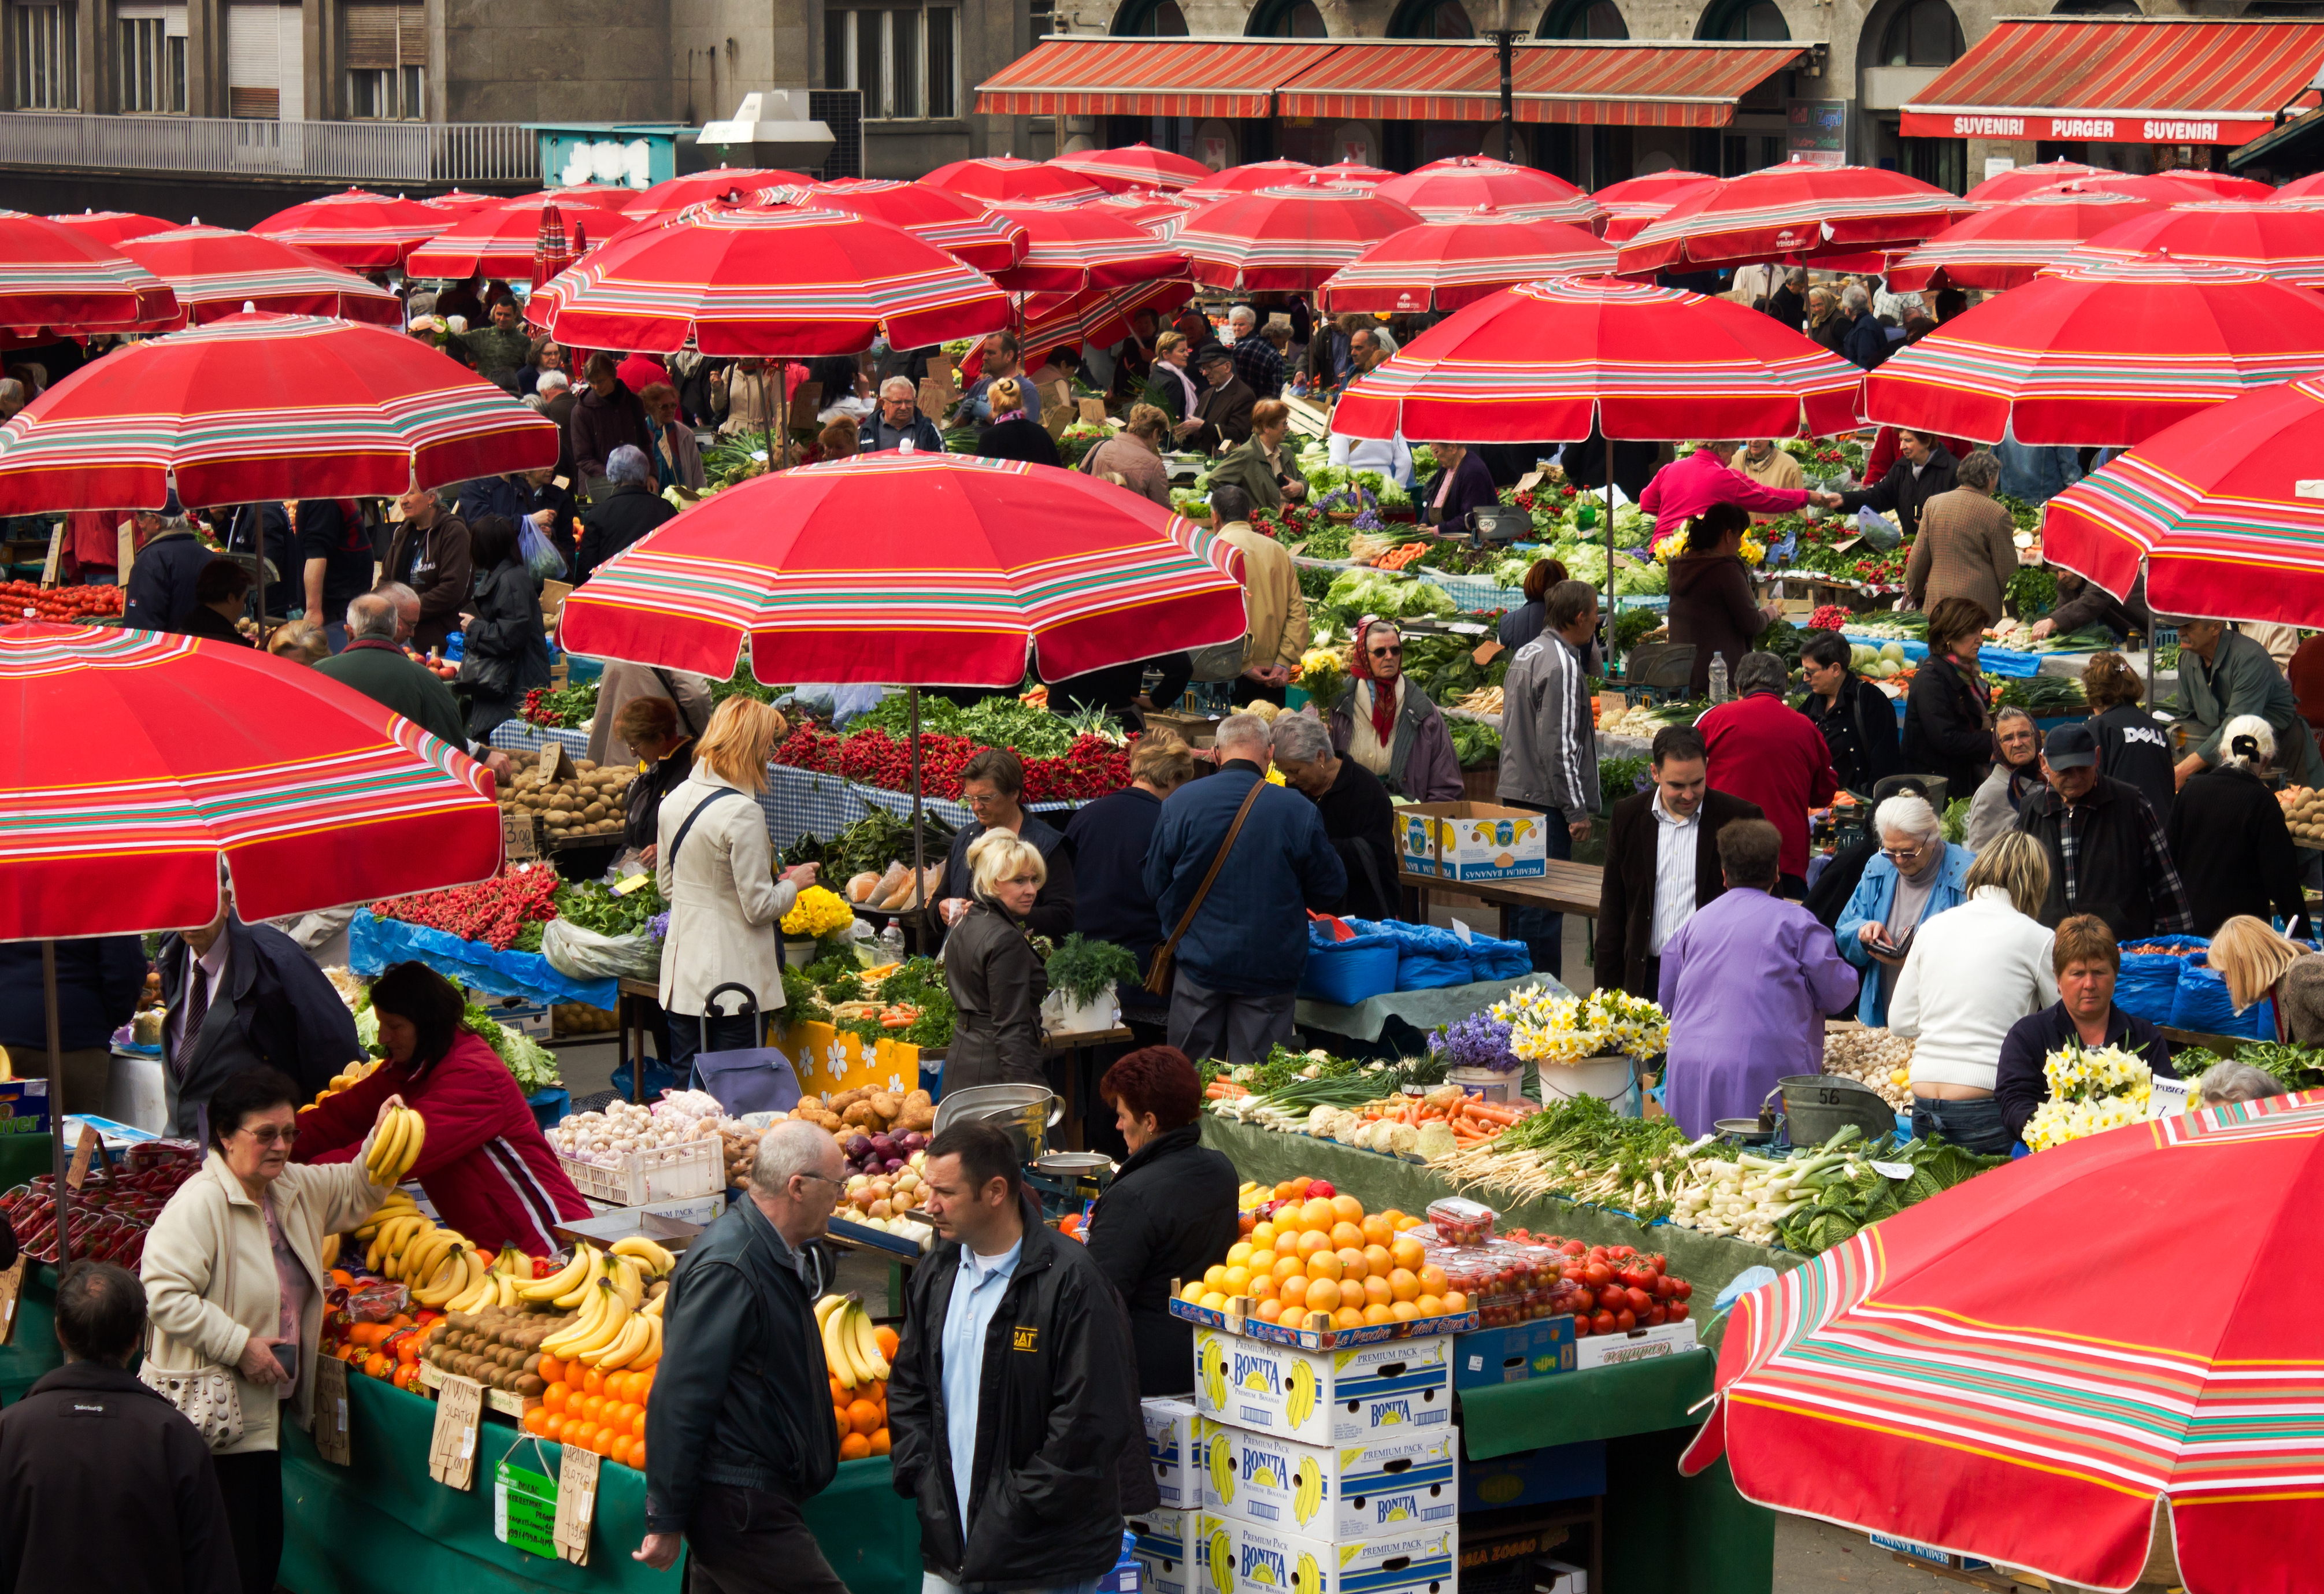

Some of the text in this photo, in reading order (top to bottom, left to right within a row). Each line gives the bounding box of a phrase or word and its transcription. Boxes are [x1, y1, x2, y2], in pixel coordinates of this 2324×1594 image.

[1817, 109, 1842, 131] Zagreb
[1954, 117, 2218, 140] SUVENIRI PURGER SUVENIRI
[2122, 726, 2166, 748] DELL
[1466, 867, 1540, 879] PREMIUM BANANAS
[1819, 1088, 1840, 1105] 56
[674, 1208, 693, 1217] PACK
[1014, 1332, 1035, 1348] CAT
[1334, 1325, 1392, 1347] Le Pesche
[1235, 1339, 1283, 1359] PREMIUM PACK
[1358, 1350, 1396, 1363] PREMIUM
[1398, 1347, 1418, 1358] PACK
[1234, 1352, 1283, 1396] BONITA
[440, 1375, 468, 1405] KIWI
[1235, 1388, 1280, 1404] PREMIUM BANANAS
[1370, 1399, 1413, 1428] BONITA
[1243, 1433, 1290, 1454] PREMIUM PACK
[1364, 1447, 1402, 1459] PREMIUM
[1404, 1443, 1423, 1453] PACK
[563, 1466, 590, 1488] SLATKA
[1241, 1447, 1289, 1491] BONITA
[1243, 1481, 1288, 1500] PREMIUM BANANAS
[1377, 1495, 1419, 1523] BONITA
[1243, 1530, 1289, 1551] PREMIUM PACK
[1362, 1543, 1400, 1556] PREMIUM
[1402, 1539, 1422, 1549] PACK
[1915, 1545, 1949, 1565] REMIUM
[1240, 1543, 1288, 1589] BONITA
[1242, 1578, 1263, 1591] PREMIUM
